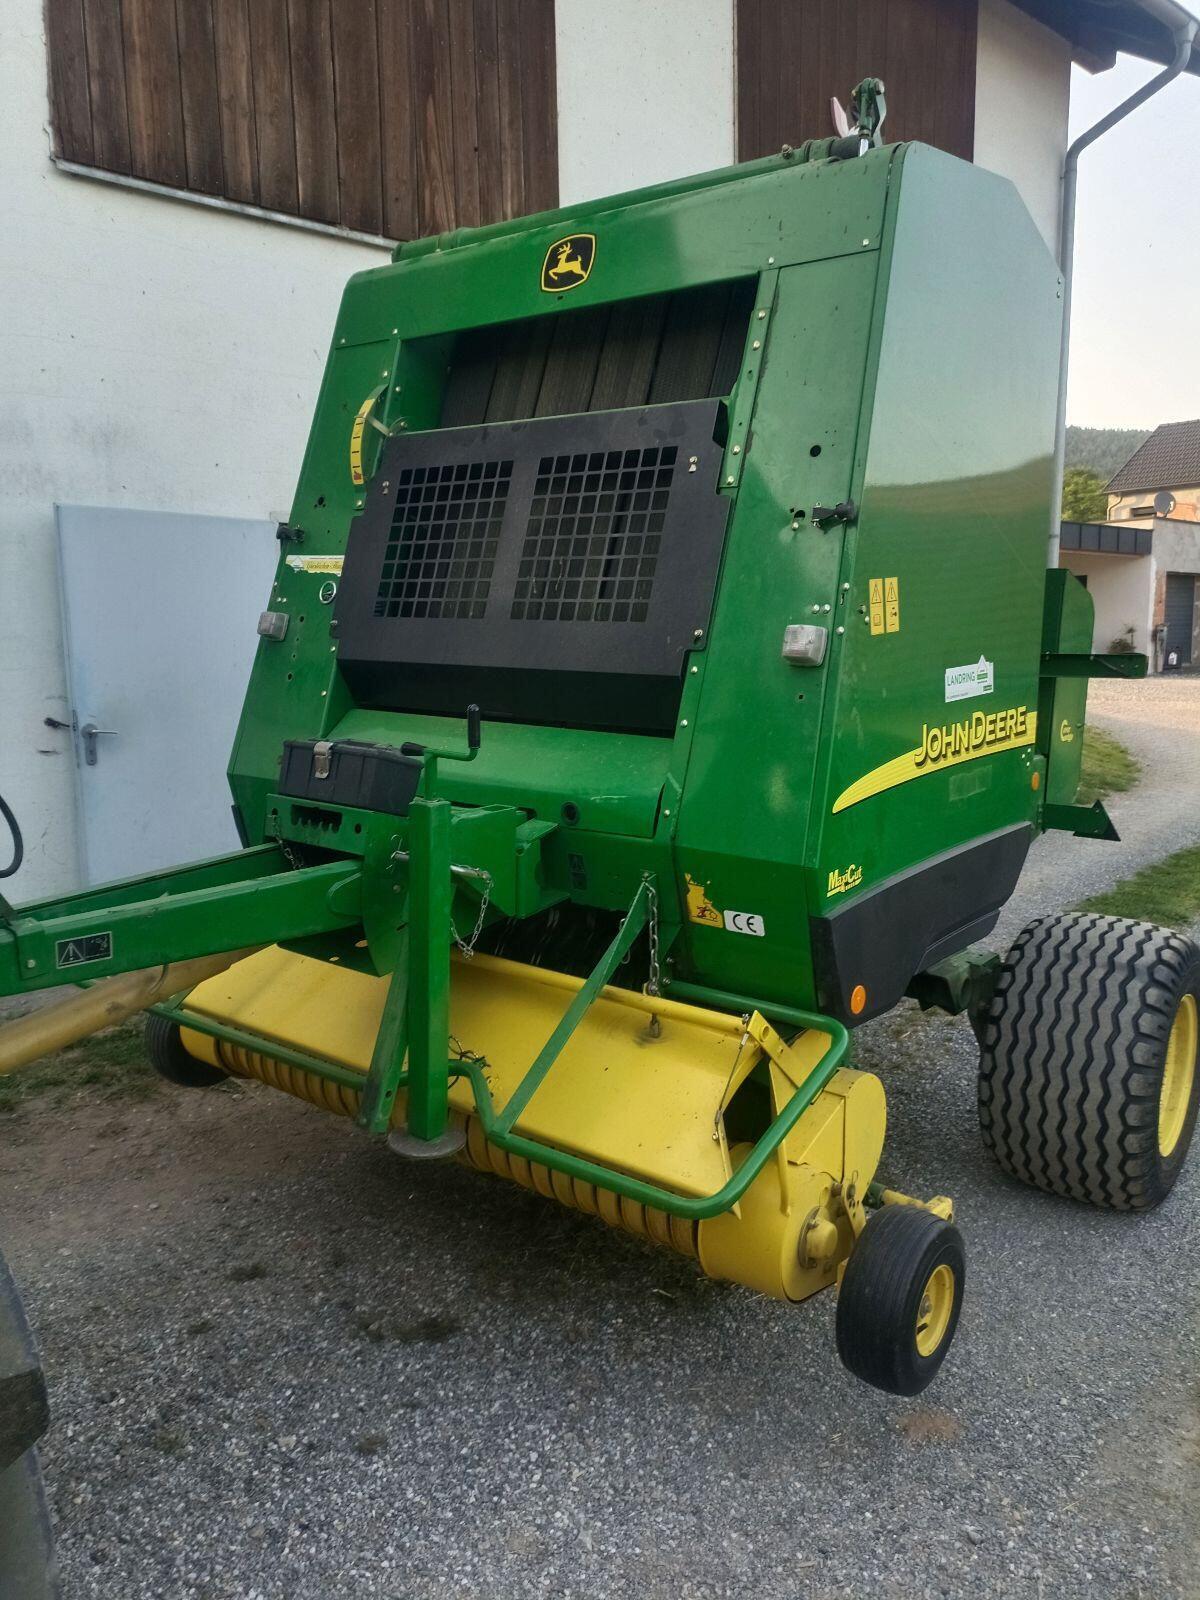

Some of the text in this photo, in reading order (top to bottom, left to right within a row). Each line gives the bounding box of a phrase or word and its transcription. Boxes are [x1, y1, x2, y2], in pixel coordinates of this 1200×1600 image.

[947, 671, 976, 687] LANDRING
[914, 721, 969, 766] JOHN
[970, 705, 1027, 749] DEERE
[828, 863, 863, 892] MaxiCut
[732, 913, 757, 933] CE
